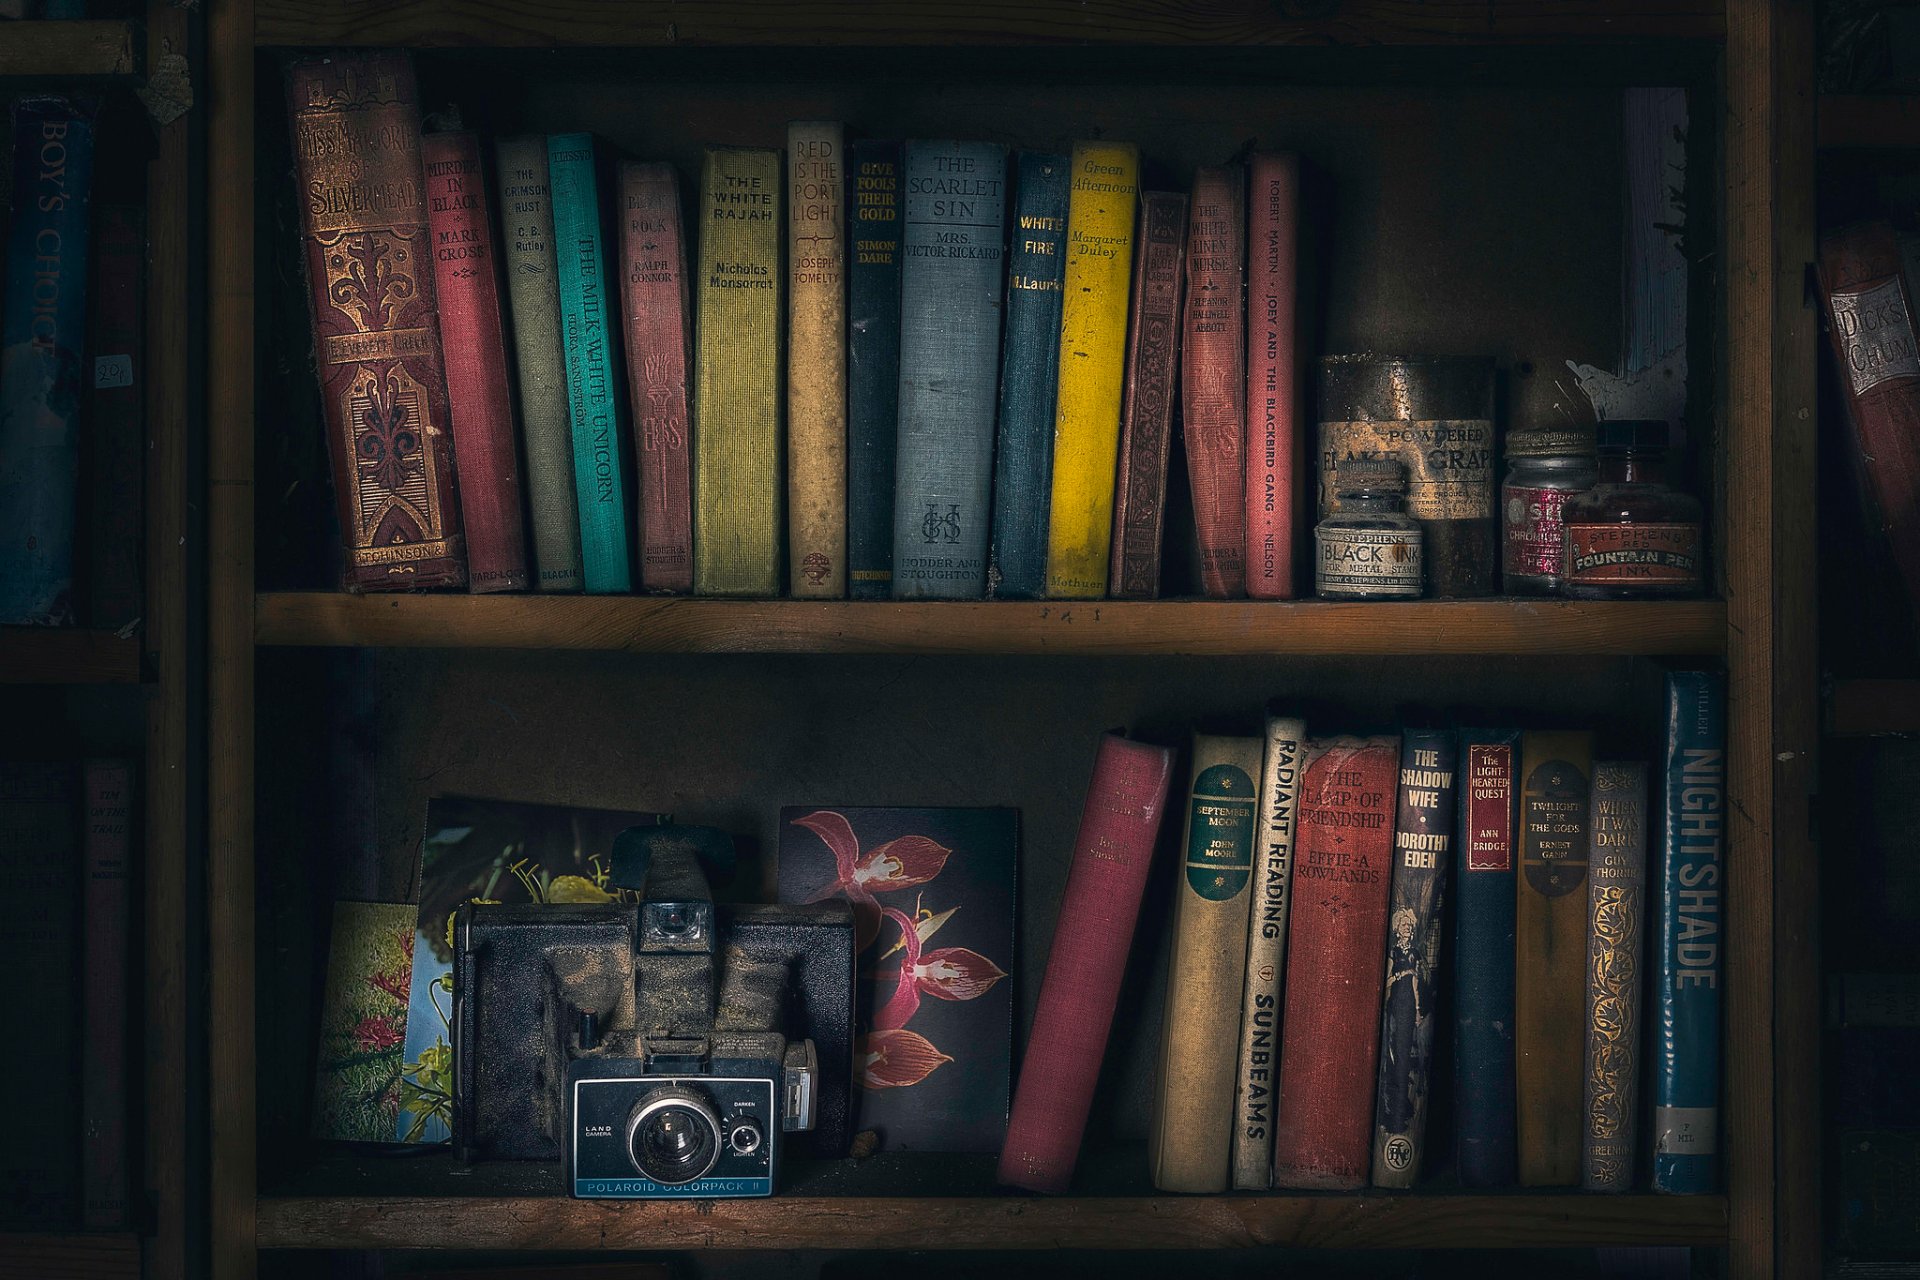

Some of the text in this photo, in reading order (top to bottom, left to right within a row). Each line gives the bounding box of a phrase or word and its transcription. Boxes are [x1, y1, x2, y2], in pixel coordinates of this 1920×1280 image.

[797, 141, 832, 157] RED
[39, 119, 70, 212] BOY'S
[428, 160, 478, 177] MURDER
[794, 162, 837, 178] IS THE
[861, 162, 893, 175] GIVE
[934, 157, 975, 173] THE
[1085, 160, 1124, 175] Green
[516, 170, 533, 179] THE
[447, 178, 463, 193] IN
[726, 177, 761, 188] THE
[857, 177, 896, 190] FOOLS
[910, 178, 1001, 196] SCARLET
[1072, 178, 1135, 194] Afternoon
[310, 178, 417, 215] SILVERMEAD
[505, 185, 547, 196] CRIMSON
[795, 184, 837, 200] PORT
[432, 195, 479, 212] BLACK
[713, 193, 772, 204] WHITE
[858, 192, 895, 205] THEIR
[515, 201, 540, 212] RUST
[793, 205, 838, 221] LIGHT
[934, 200, 975, 217] SIN
[1198, 205, 1219, 217] THE
[714, 209, 772, 220] RAJAH
[859, 208, 895, 221] GOLD
[632, 219, 667, 233] ROCK
[1020, 215, 1063, 231] WHITE
[1192, 221, 1228, 235] WHITE
[439, 229, 480, 244] MARK
[518, 226, 540, 236] C. B.
[936, 232, 971, 244] MRS.
[1071, 231, 1128, 245] Margaret
[516, 241, 544, 251] Rutley
[857, 241, 896, 251] SIMON
[906, 246, 1000, 259] VICTOR RICKARD
[1025, 240, 1055, 255] FIRE
[1079, 245, 1117, 259] Duley
[1194, 240, 1227, 253] LINEN
[439, 246, 483, 261] CROSS
[857, 253, 892, 264] DARE
[634, 261, 668, 271] RALPH
[716, 263, 768, 274] Nicholas
[796, 258, 834, 268] JOSEPH
[1194, 258, 1228, 271] NURSE
[631, 273, 672, 283] CONNOR
[710, 276, 773, 289] Monsarrat
[794, 273, 838, 284] TOMELTY
[1840, 300, 1905, 336] DICK'S
[1850, 341, 1911, 371] CHUM
[578, 235, 614, 504] THE MILK-WHITE UNICORN
[1264, 180, 1280, 578] ROBERT MARTIN JOEY AND THE BLACKBIRD GANG NELSON
[572, 357, 585, 427] SANDSTRÖM
[1344, 534, 1403, 543] STEPHENS
[1623, 540, 1650, 548] RED
[1325, 545, 1417, 563] BLACK INK
[1576, 551, 1693, 570] FOUNTAIN PEN
[901, 559, 981, 568] HODDER AND
[1325, 563, 1383, 573] FOR METAL
[900, 570, 979, 579] STOUGHTON
[1617, 566, 1653, 576] INK
[1414, 749, 1439, 767] THE
[1401, 768, 1452, 789] SHADOW
[1477, 768, 1504, 776] LIGHT-
[1325, 772, 1362, 786] THE
[1472, 778, 1508, 788] HEARTED
[1306, 788, 1382, 808] LAMP OF
[1408, 790, 1439, 808] WIFE
[1475, 789, 1504, 800] QUEST
[1197, 806, 1250, 817] SEPTEMBER
[1532, 802, 1579, 811] TWILIGHT
[1599, 801, 1638, 814] WHEN
[1209, 818, 1239, 826] MOON
[1300, 808, 1385, 829] FRIENDSHIP
[1595, 817, 1640, 831] IT WAS
[1480, 830, 1498, 838] ANN
[1530, 824, 1580, 833] THE GODS
[1210, 840, 1233, 848] JOHN
[1262, 740, 1297, 939] RADIANT READING
[1396, 832, 1450, 851] DOROTHY
[1539, 841, 1572, 849] ERNEST
[1597, 833, 1637, 847] DARK
[1205, 849, 1236, 857] MOORE
[1473, 842, 1505, 851] BRIDGE
[1309, 851, 1368, 868] EFFIE A
[1404, 851, 1436, 868] EDEN
[1542, 851, 1568, 859] GANN
[1605, 856, 1626, 865] GUY
[1298, 865, 1379, 883] ROWLANDS
[1676, 749, 1721, 990] NIGHTSHADE
[1246, 994, 1275, 1140] SUNBEAMS
[587, 1183, 656, 1192] POLAROID
